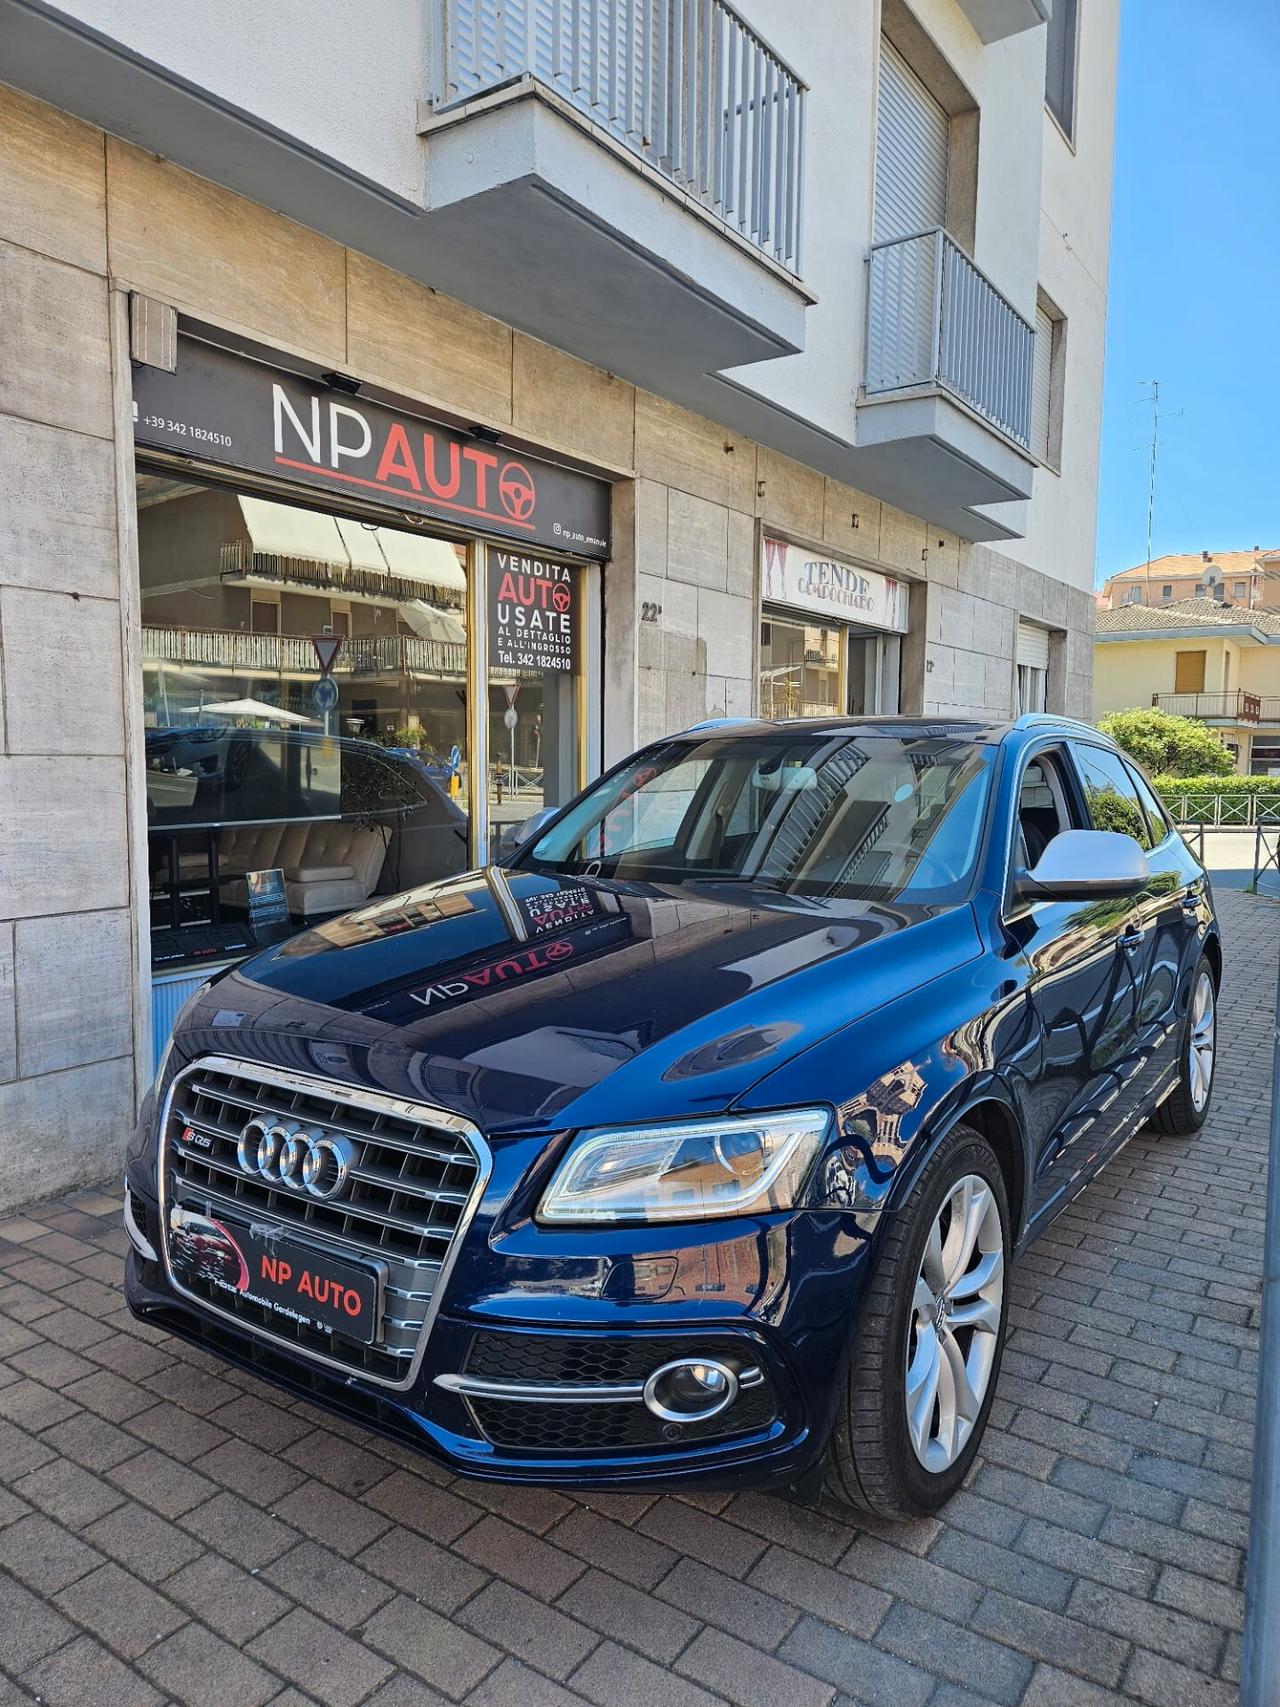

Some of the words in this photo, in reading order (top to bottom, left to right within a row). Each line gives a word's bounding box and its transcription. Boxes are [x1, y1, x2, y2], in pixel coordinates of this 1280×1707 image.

[143, 416, 165, 428] +39
[167, 420, 187, 435] 342
[189, 426, 232, 447] 1824510
[497, 552, 571, 583] VENDITA
[497, 603, 571, 633] USATE
[497, 637, 503, 646] E
[507, 639, 571, 654] ALL'INGROSSO
[498, 626, 511, 636] AL
[516, 628, 571, 644] DETTAGLIO
[498, 650, 515, 664] Tel.
[517, 653, 534, 666] 342
[536, 655, 571, 670] 1824510
[260, 1255, 292, 1285] NP
[297, 1270, 362, 1317] AUTO
